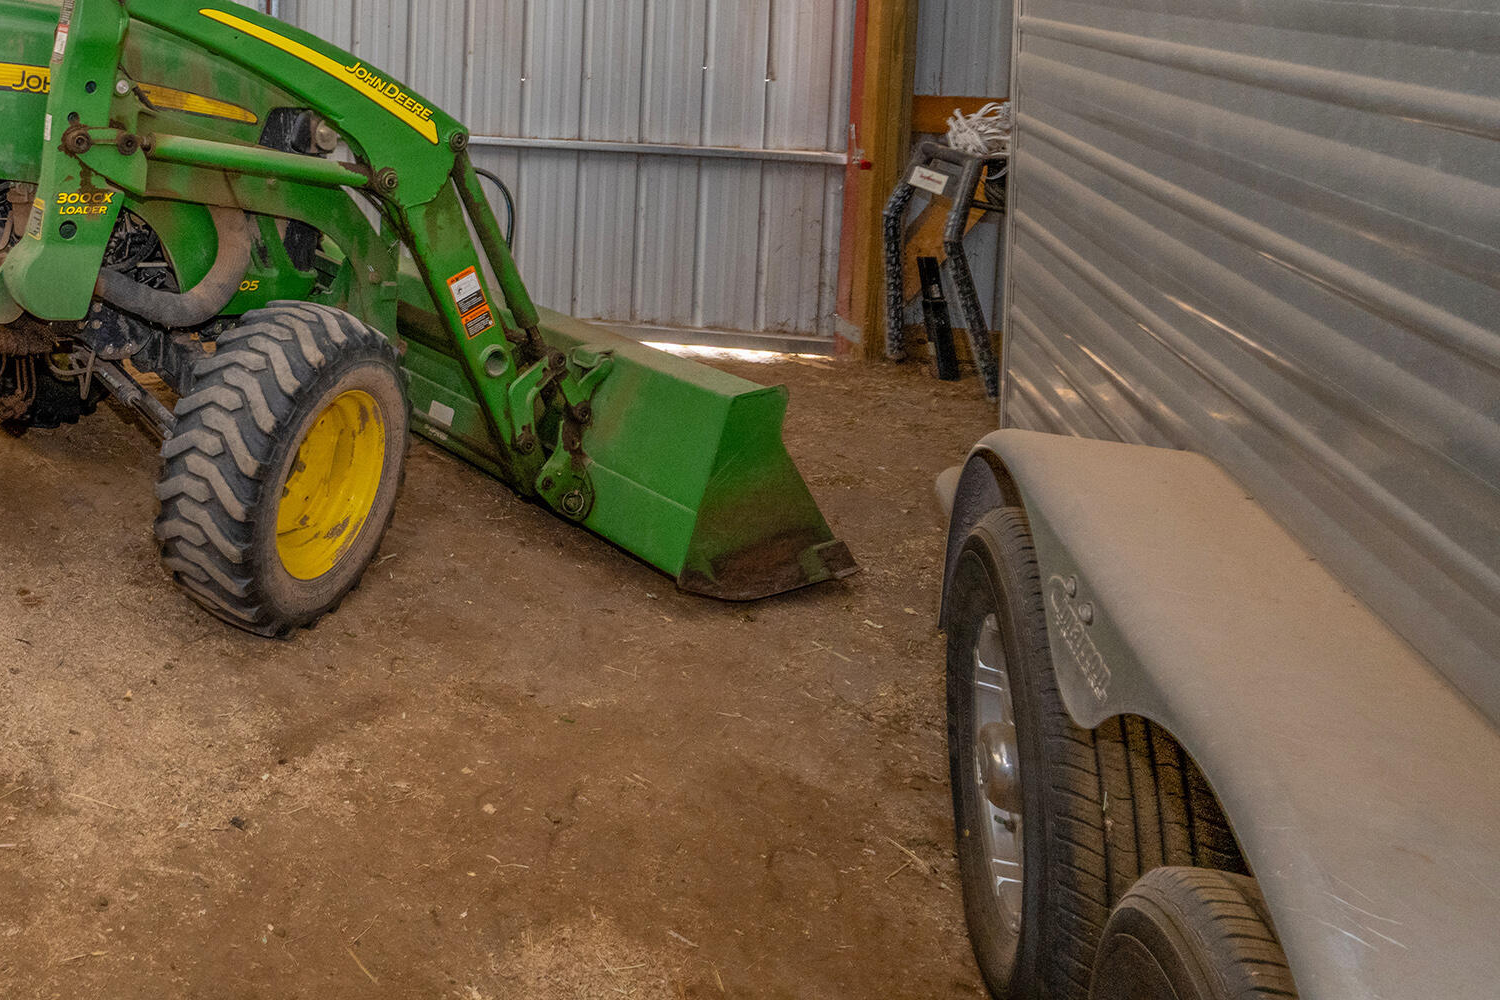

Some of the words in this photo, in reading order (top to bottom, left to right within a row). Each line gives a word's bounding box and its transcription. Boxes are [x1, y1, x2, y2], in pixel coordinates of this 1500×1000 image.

[12, 70, 50, 91] JOH
[344, 62, 387, 92] JOHN
[383, 83, 434, 121] DEERE
[58, 206, 108, 216] LOADER
[239, 280, 260, 291] 05
